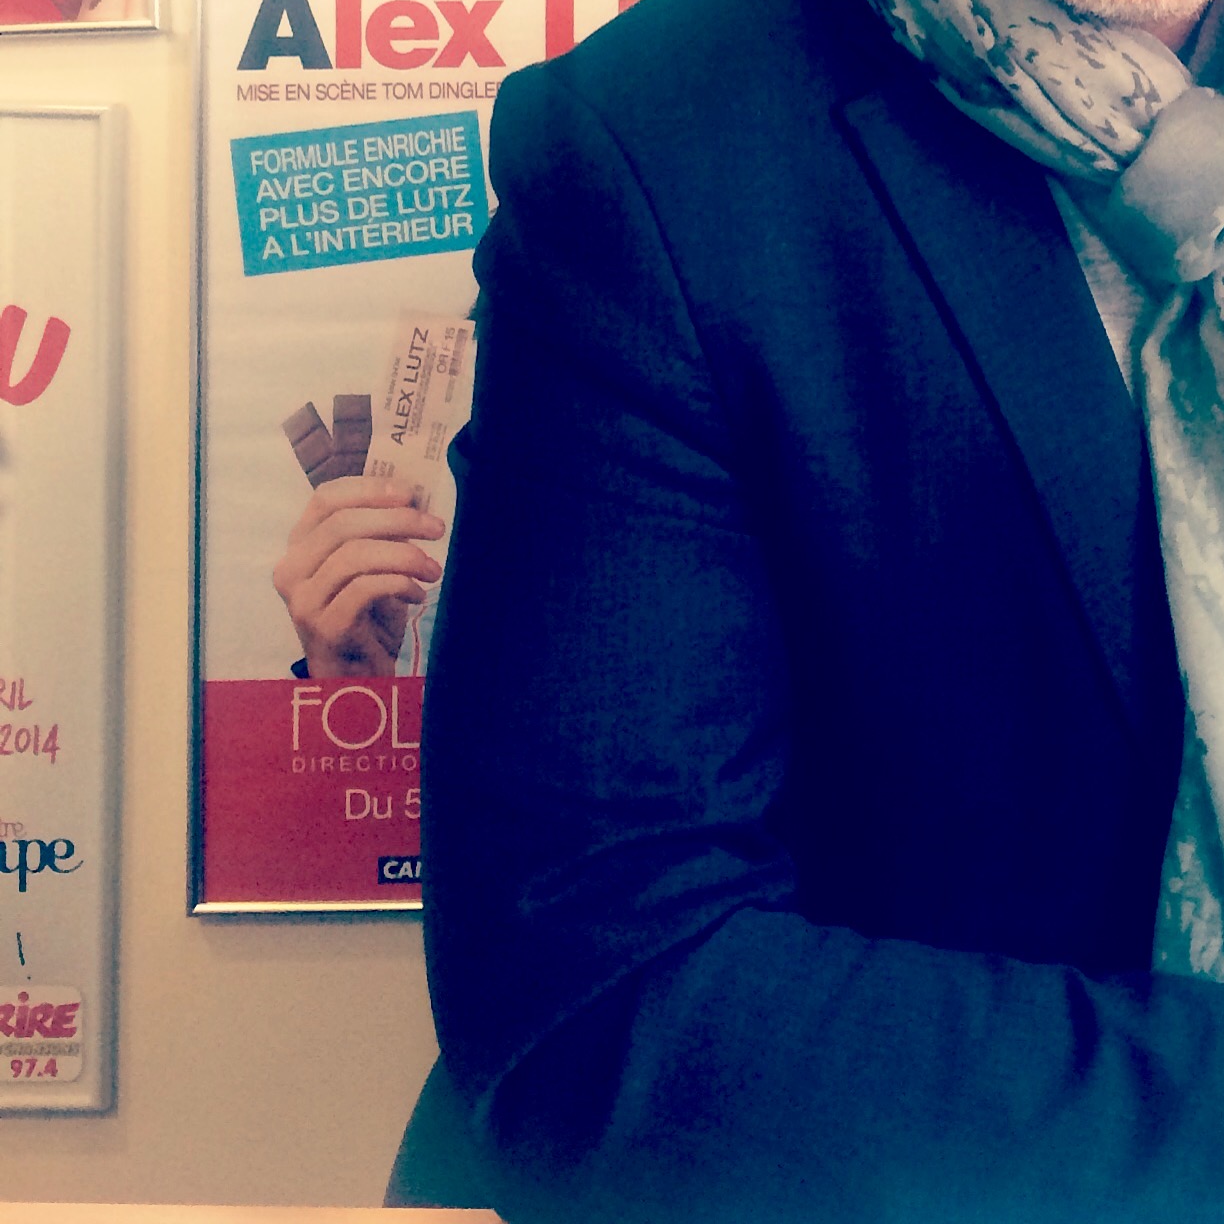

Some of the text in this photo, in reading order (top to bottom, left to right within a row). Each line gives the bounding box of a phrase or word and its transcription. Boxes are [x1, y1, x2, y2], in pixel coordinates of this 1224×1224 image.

[236, 83, 280, 103] MISE
[285, 83, 311, 102] EN
[315, 77, 377, 101] SCÈNE
[382, 81, 424, 100] TOM
[250, 126, 467, 176] FORMULE ENRICHIE
[256, 155, 471, 204] AVEC ENCORE
[258, 184, 474, 231] PLUS DE LUTZ
[262, 212, 474, 261] A L'INTÉRIEUR
[390, 327, 429, 446] ALEX LUTZ
[291, 685, 426, 751] FOL
[345, 788, 393, 820] Du
[10, 1058, 59, 1078] 97.4
